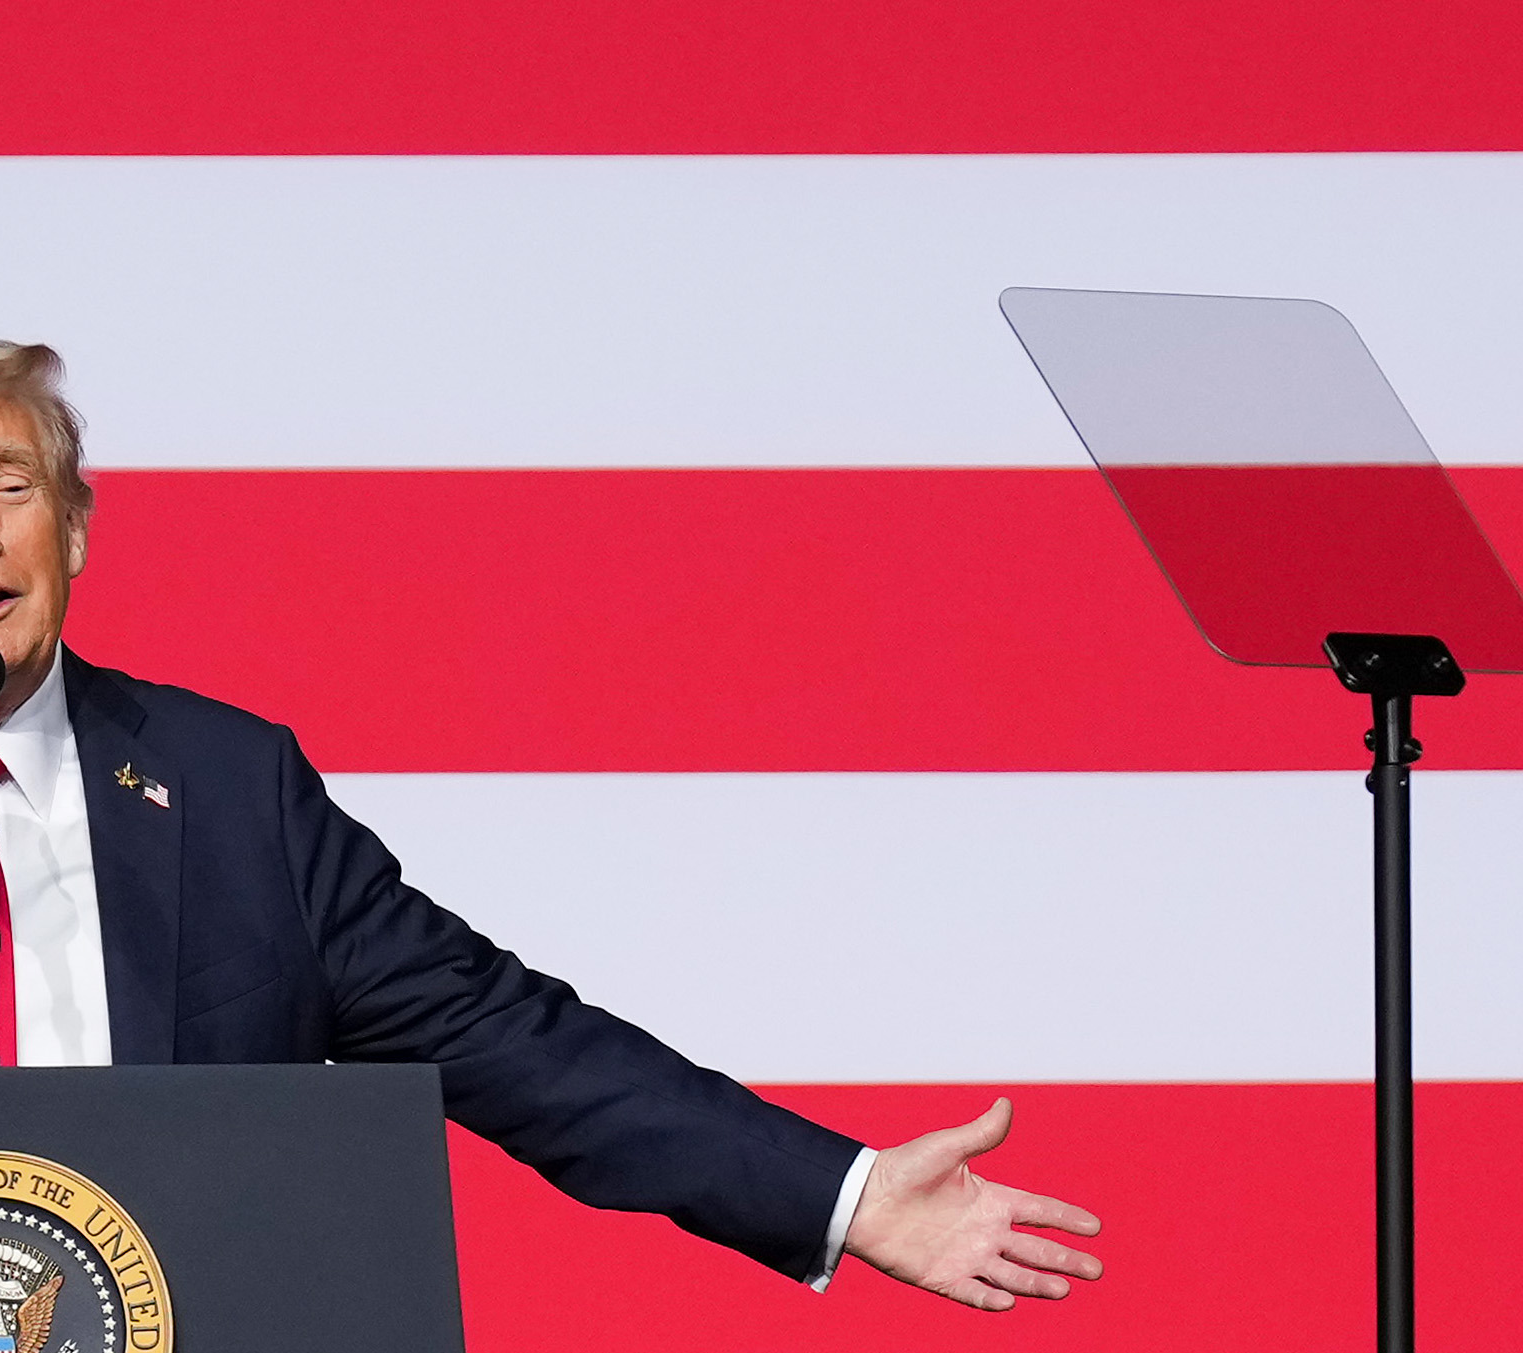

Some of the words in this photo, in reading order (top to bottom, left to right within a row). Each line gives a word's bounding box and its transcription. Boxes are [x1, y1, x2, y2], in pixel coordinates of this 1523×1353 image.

[0, 1288, 24, 1299] UNUM
[29, 1174, 76, 1210] THE
[85, 1204, 162, 1352] UNITED
